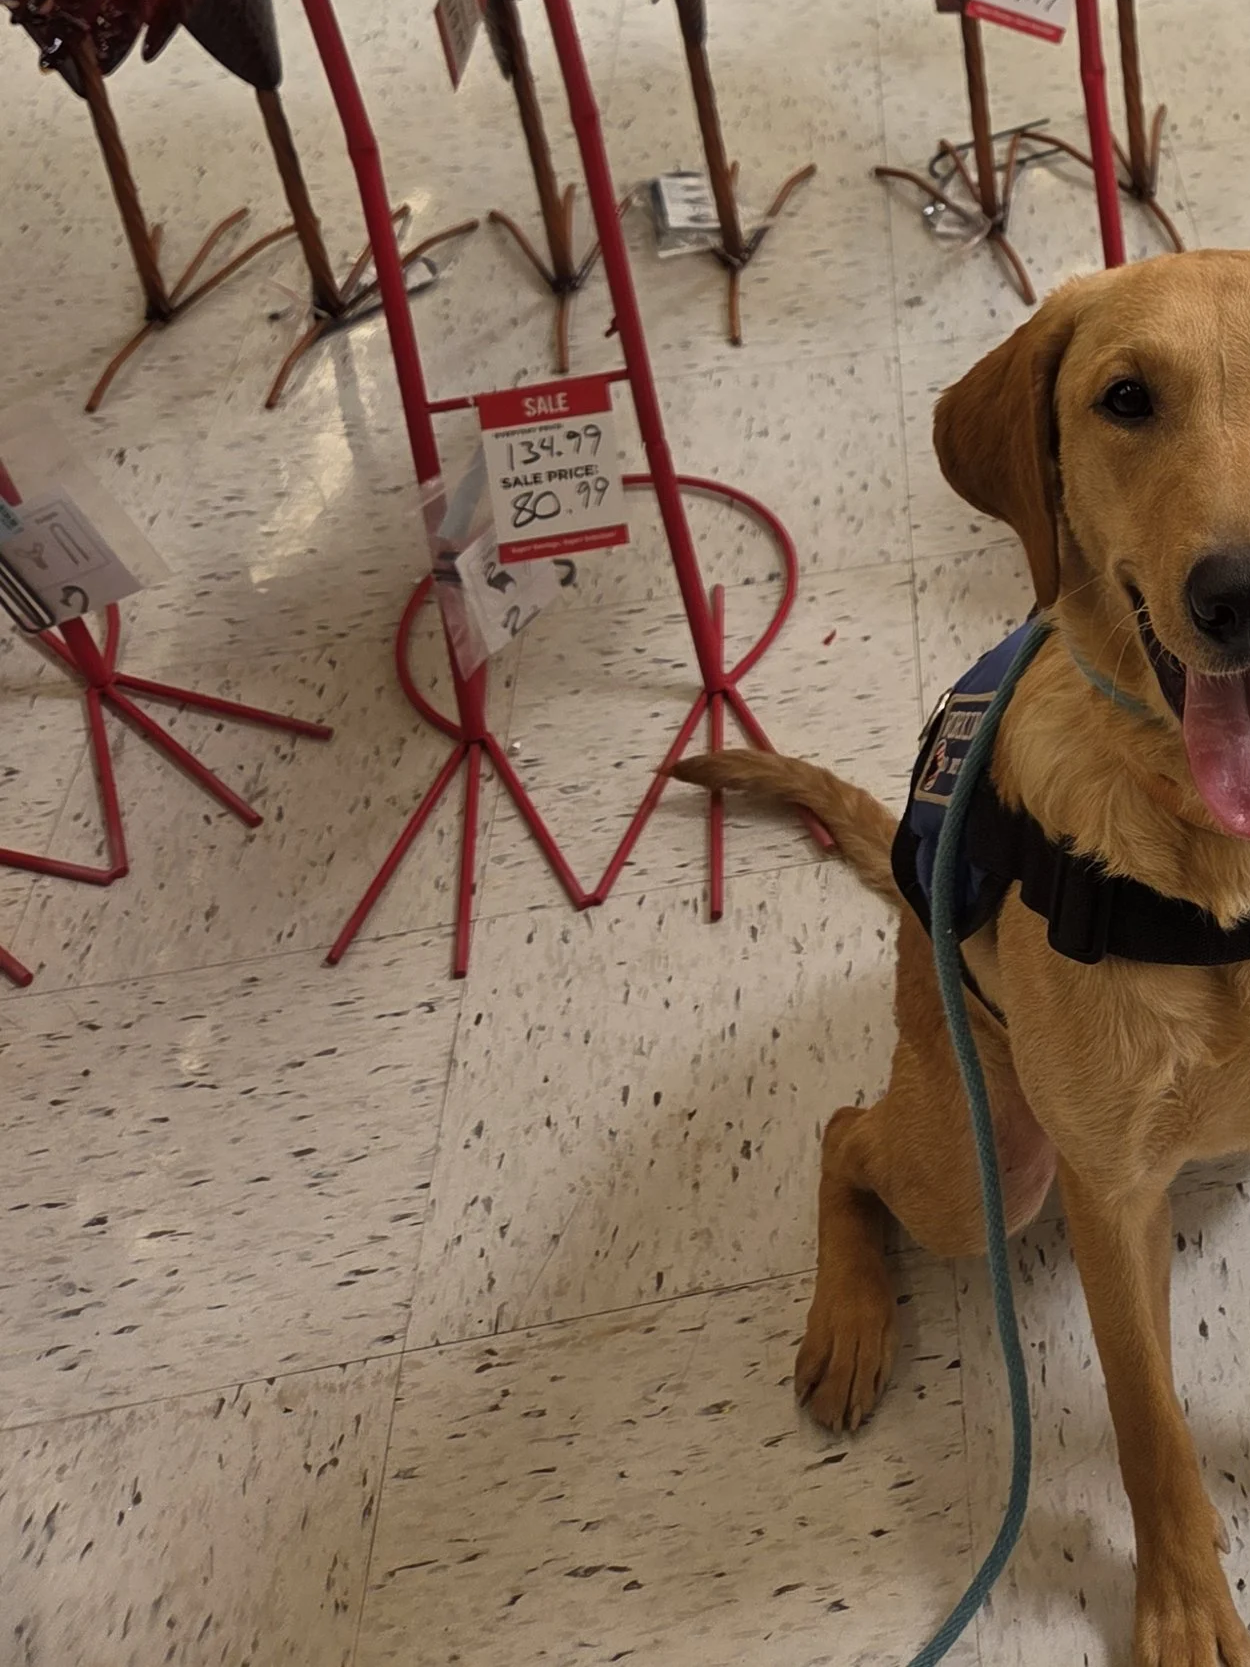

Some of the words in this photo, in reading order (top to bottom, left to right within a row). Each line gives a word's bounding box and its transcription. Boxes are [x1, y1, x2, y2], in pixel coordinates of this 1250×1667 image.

[523, 392, 570, 417] SALE
[506, 424, 602, 471] 134.99
[501, 472, 543, 490] SALE
[547, 464, 599, 483] PRICE:
[512, 476, 610, 528] 80.99
